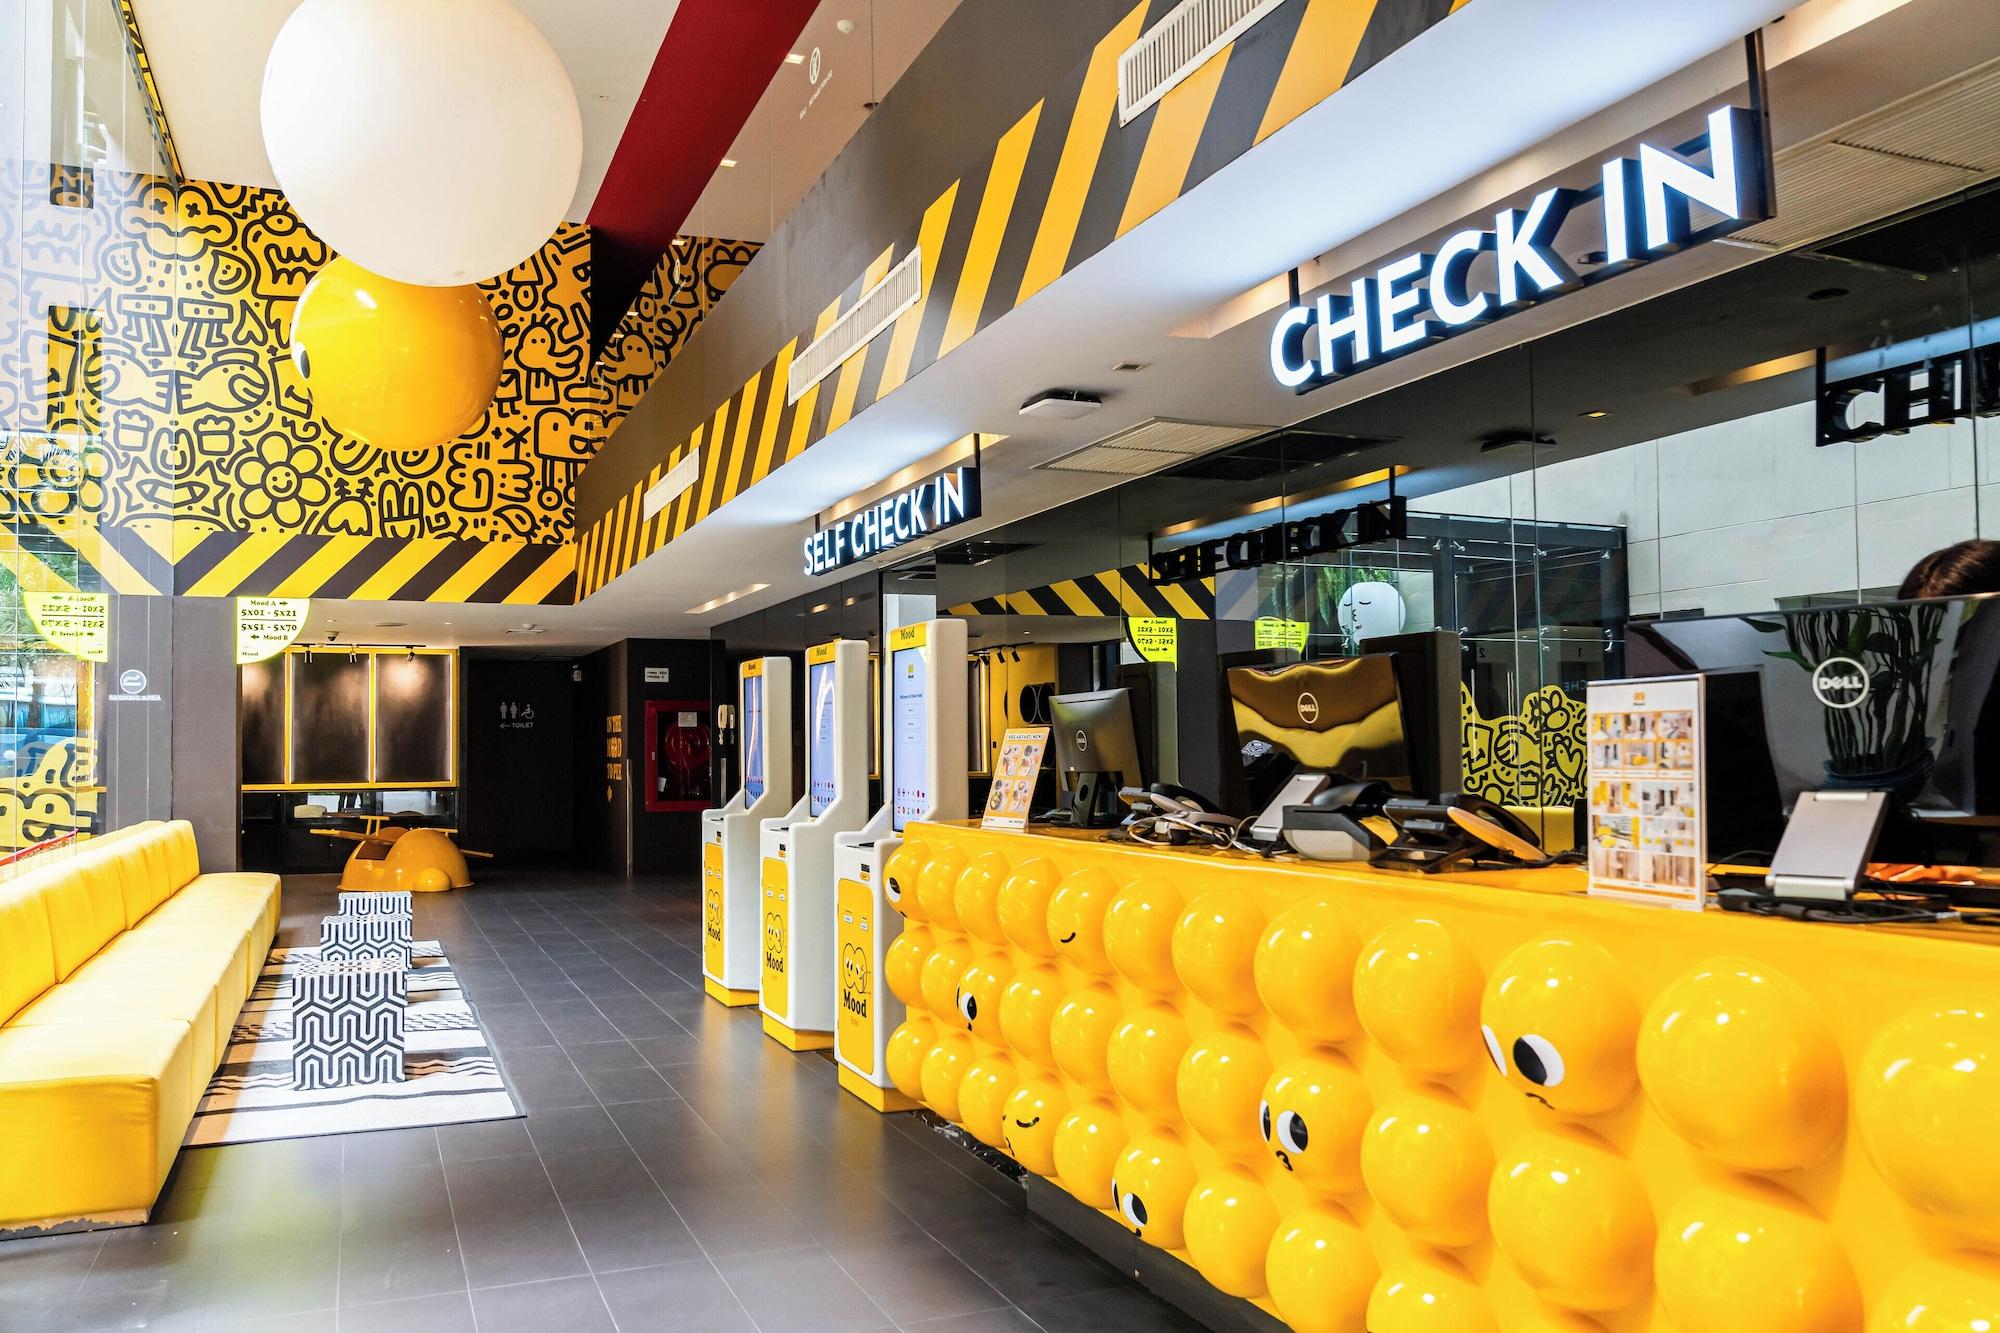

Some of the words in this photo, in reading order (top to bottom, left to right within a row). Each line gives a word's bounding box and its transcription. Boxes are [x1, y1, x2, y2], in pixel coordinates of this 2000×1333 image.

[1270, 187, 1565, 388] CHECK
[1602, 104, 1739, 265] IN
[803, 521, 846, 576] SELF
[851, 483, 928, 557] CHECK
[934, 466, 965, 526] IN
[900, 627, 915, 641] Mood
[1818, 675, 1864, 690] DELL
[511, 721, 534, 729] TOILET
[707, 922, 721, 942] Mood
[766, 951, 784, 974] Mood
[843, 988, 868, 1019] Mood
